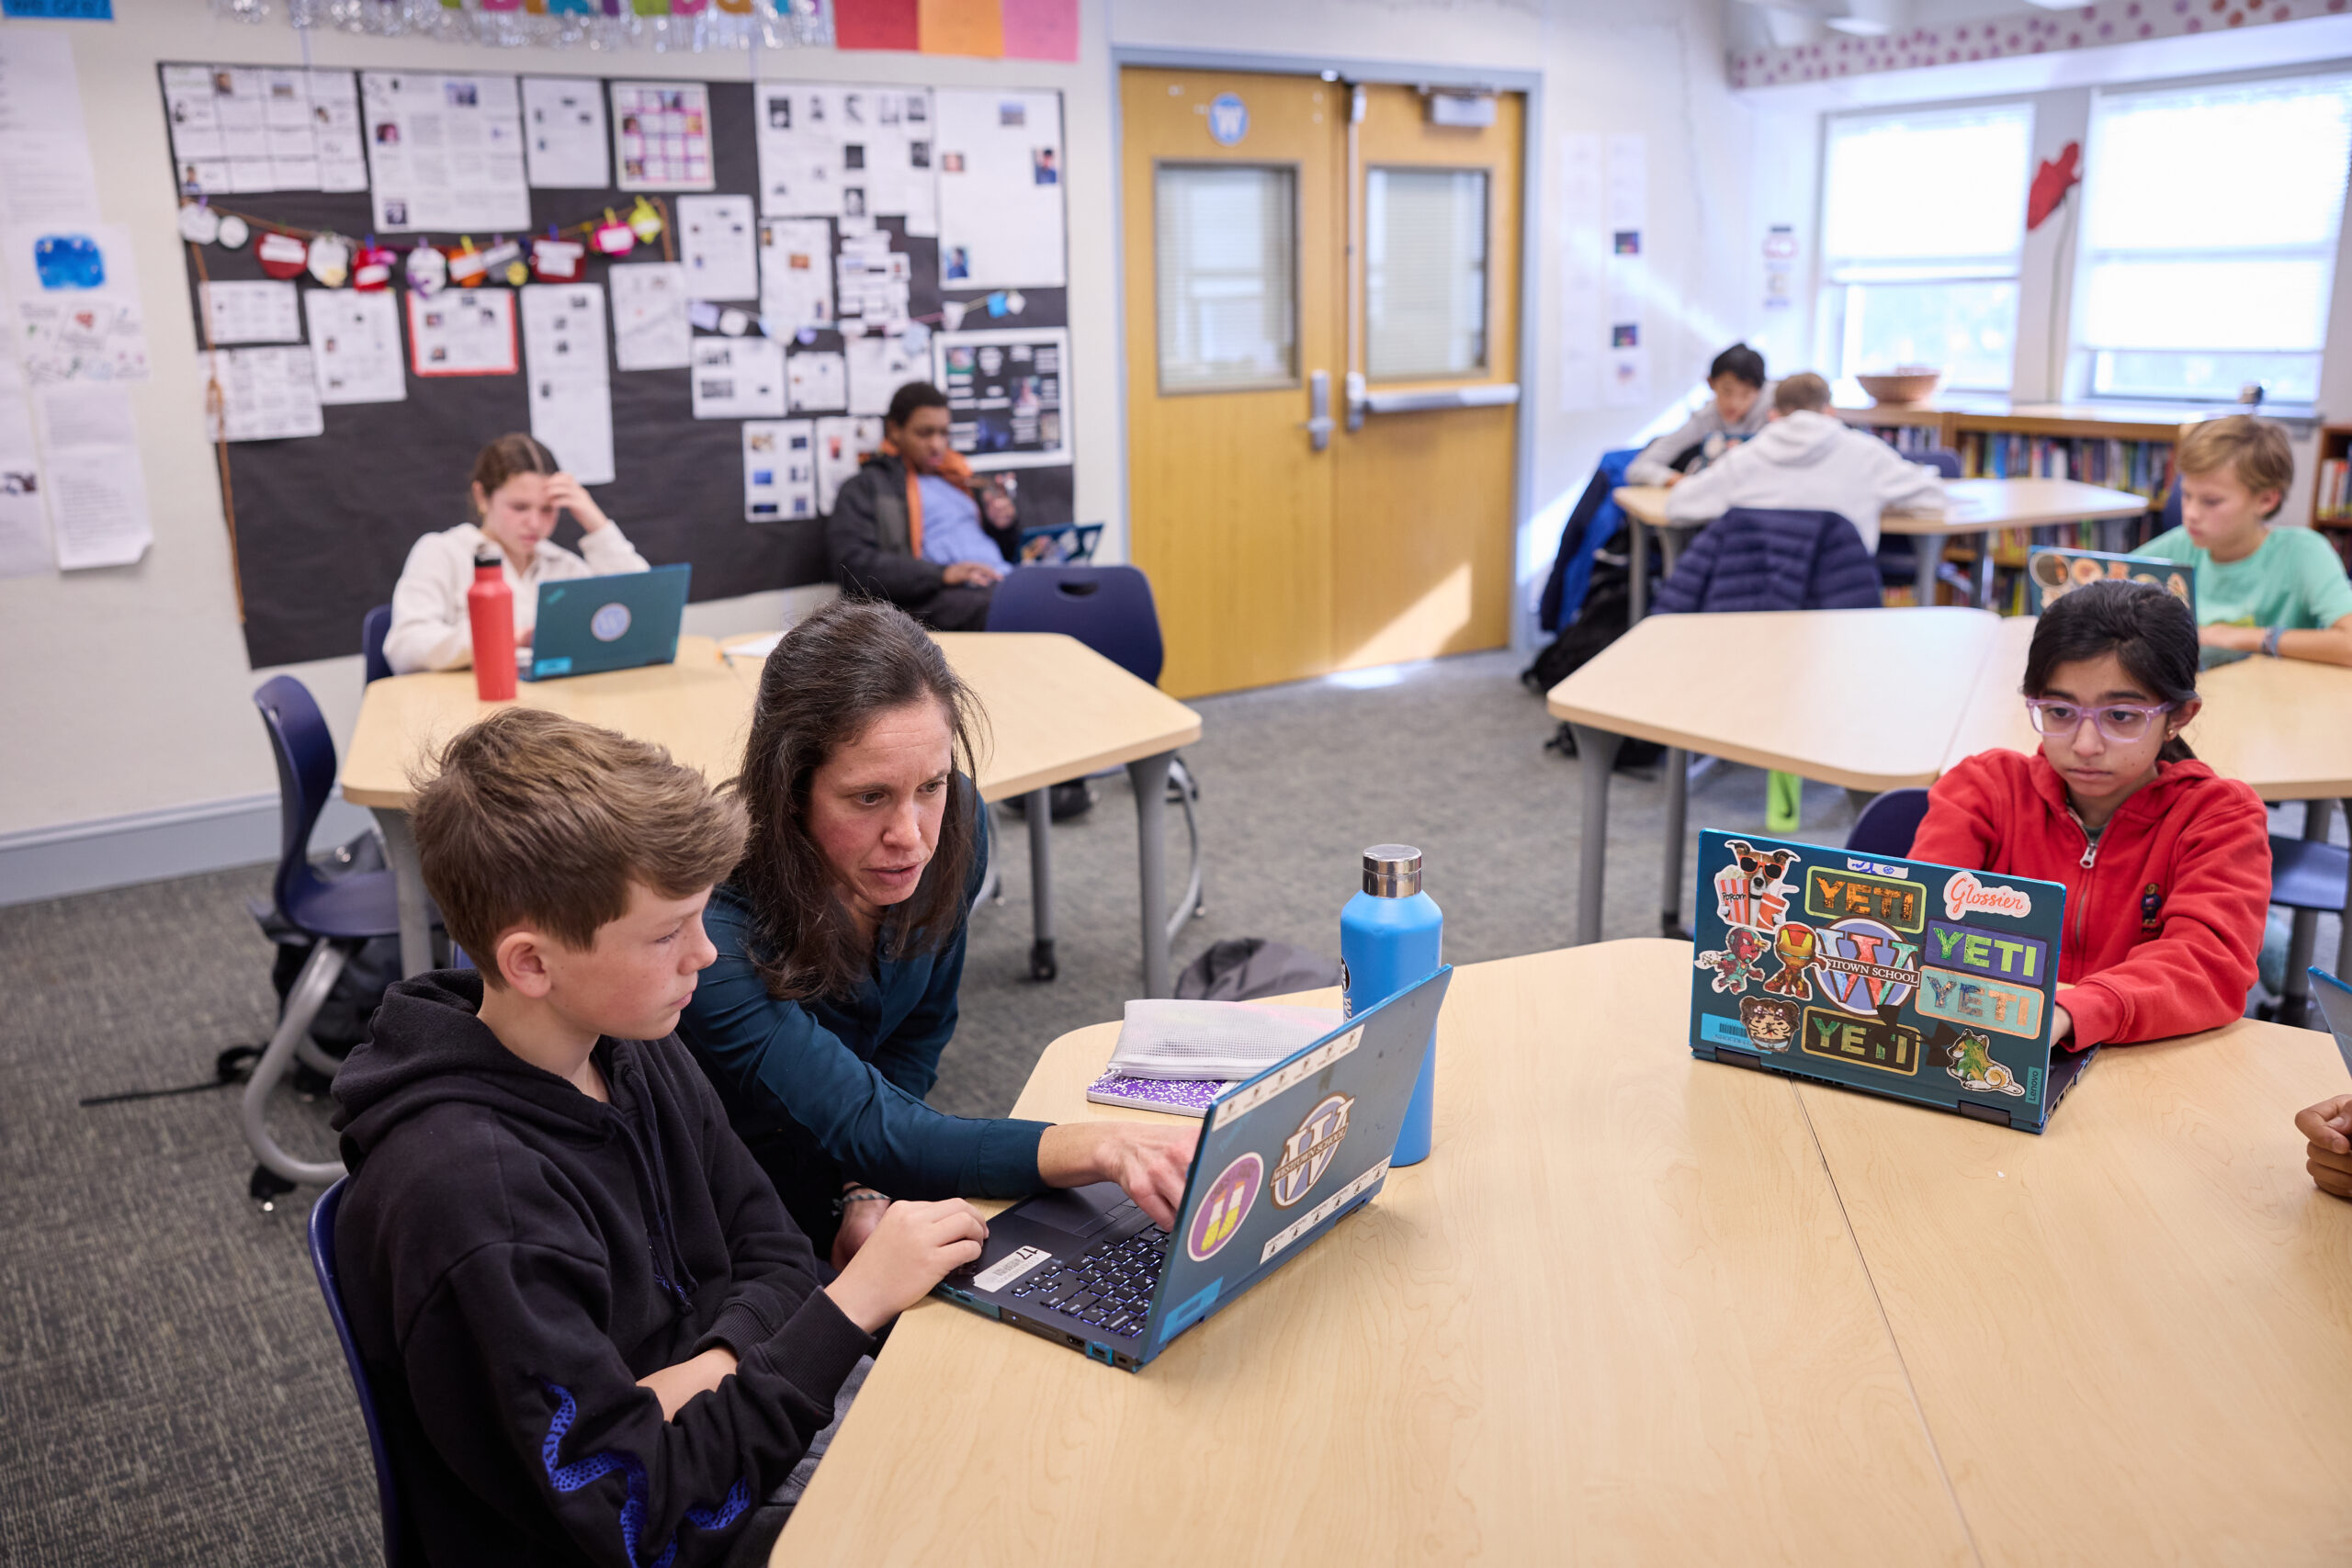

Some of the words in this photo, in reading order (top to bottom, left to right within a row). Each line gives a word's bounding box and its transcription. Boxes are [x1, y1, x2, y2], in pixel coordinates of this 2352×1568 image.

[1722, 892, 1747, 903] Popcorn
[1816, 877, 1914, 922] YETI
[1951, 877, 2024, 914] Glossier
[1815, 927, 1919, 1010] W
[1933, 928, 2037, 977] YETI
[1872, 967, 1918, 984] SCHOOL
[1927, 976, 2030, 1026] YETI
[2028, 1070, 2039, 1101] Lenovo
[1285, 1097, 1355, 1202] W
[1016, 1248, 1038, 1259] 17
